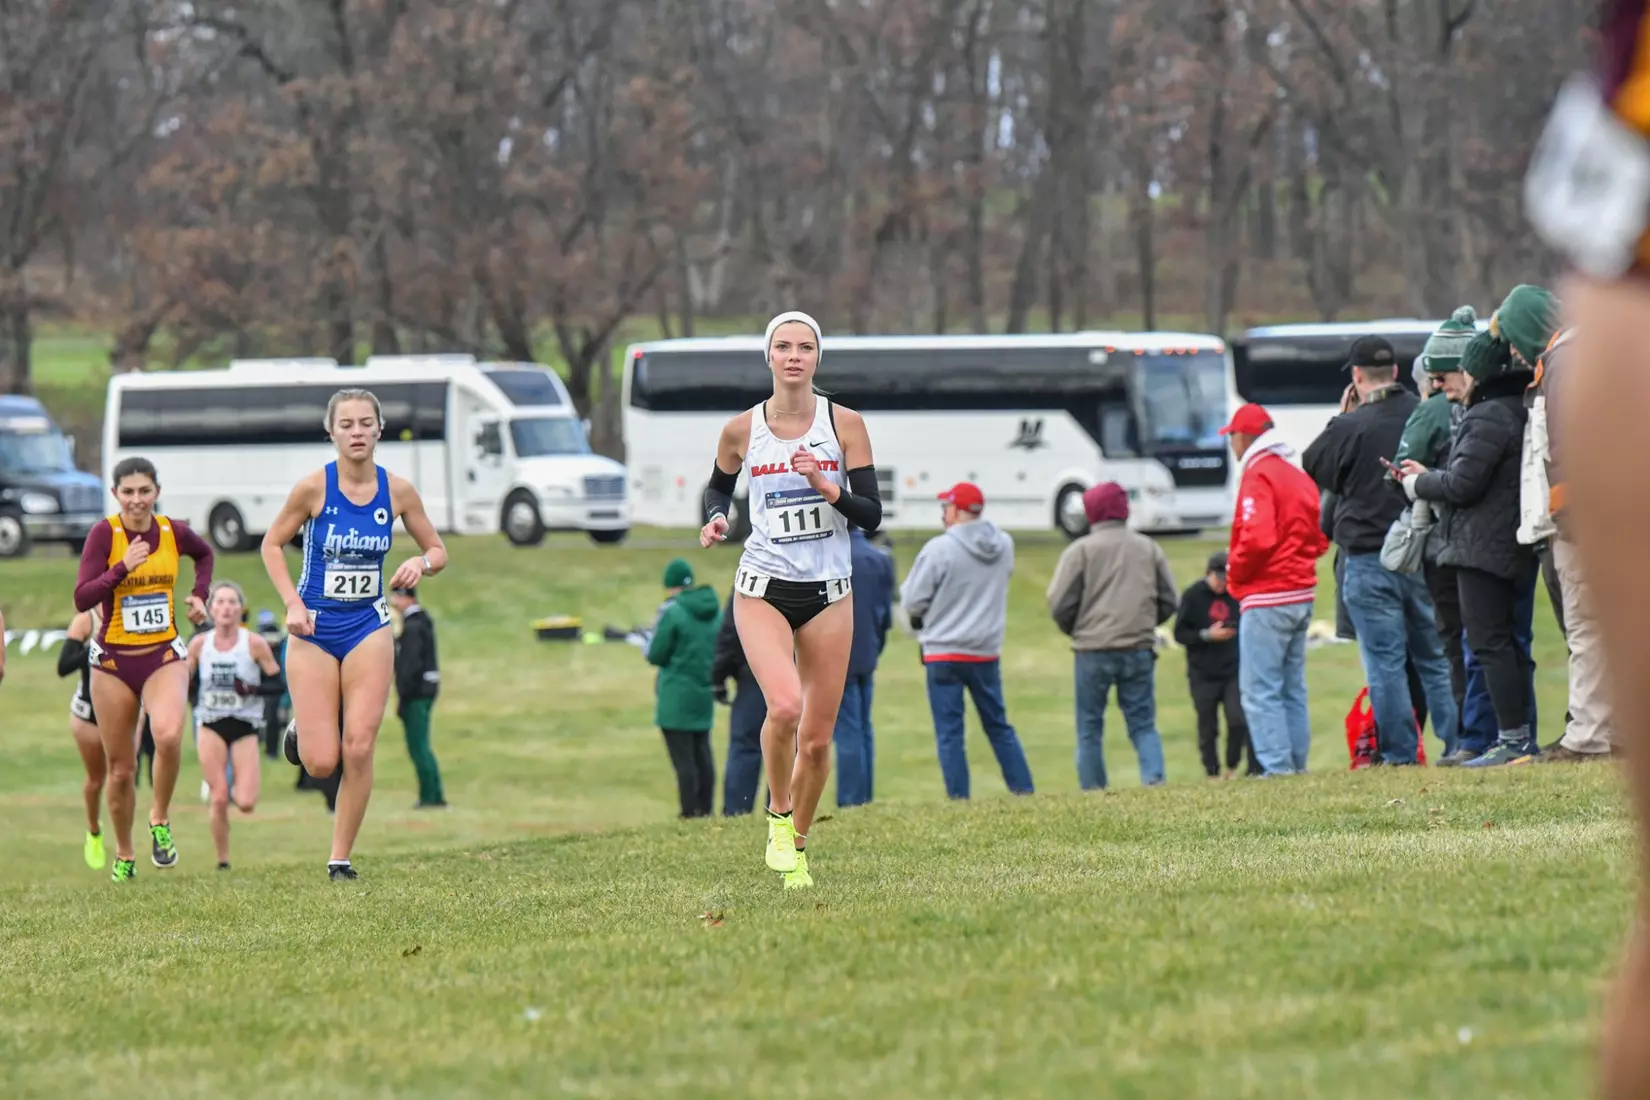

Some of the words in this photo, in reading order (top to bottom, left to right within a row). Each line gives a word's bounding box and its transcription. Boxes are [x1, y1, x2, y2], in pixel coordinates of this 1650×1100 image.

[751, 462, 789, 477] BALL
[791, 460, 839, 474] ATE
[778, 506, 822, 533] 111
[323, 523, 390, 556] Indiana
[333, 575, 372, 594] 212
[131, 608, 165, 626] 145
